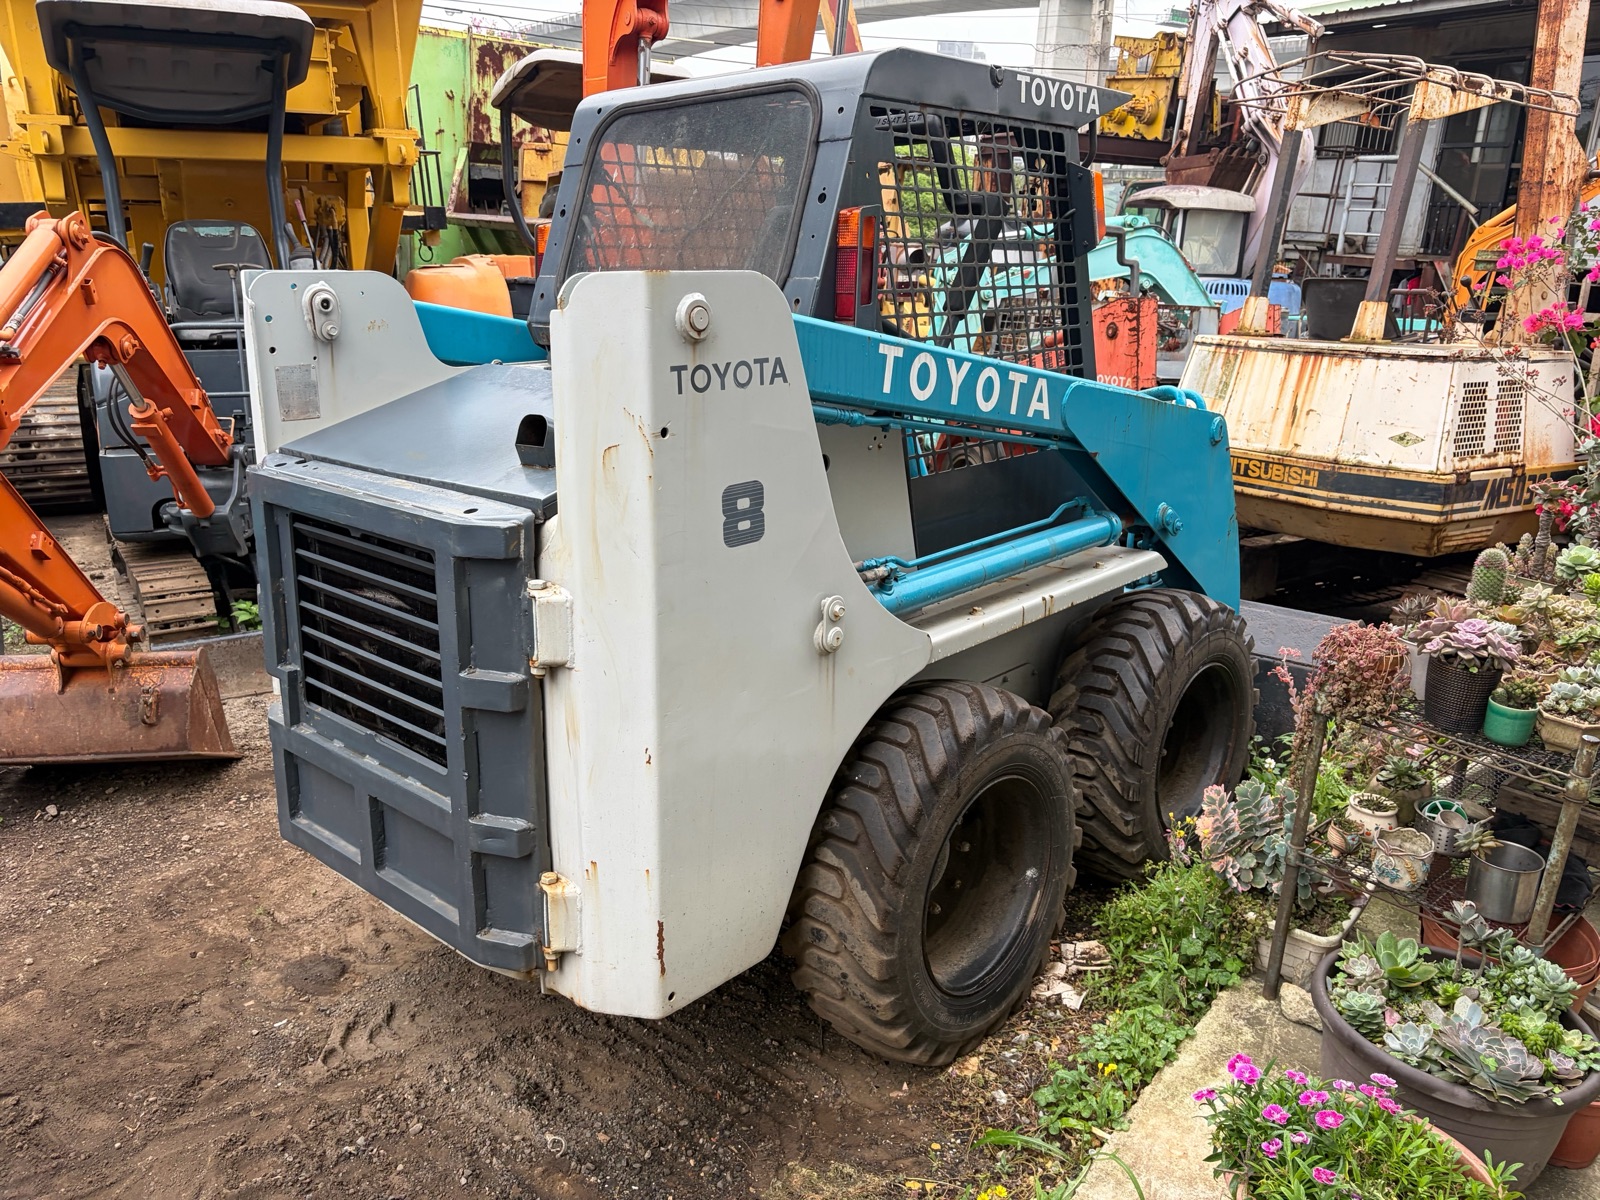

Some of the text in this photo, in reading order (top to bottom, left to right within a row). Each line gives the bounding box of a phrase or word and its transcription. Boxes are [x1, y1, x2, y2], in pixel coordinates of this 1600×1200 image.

[1016, 74, 1100, 115] TOYOTA
[669, 356, 789, 395] TOYOTA
[878, 342, 1050, 420] TOYOTA
[1230, 456, 1319, 488] ITSUBISHI
[721, 479, 766, 549] 8
